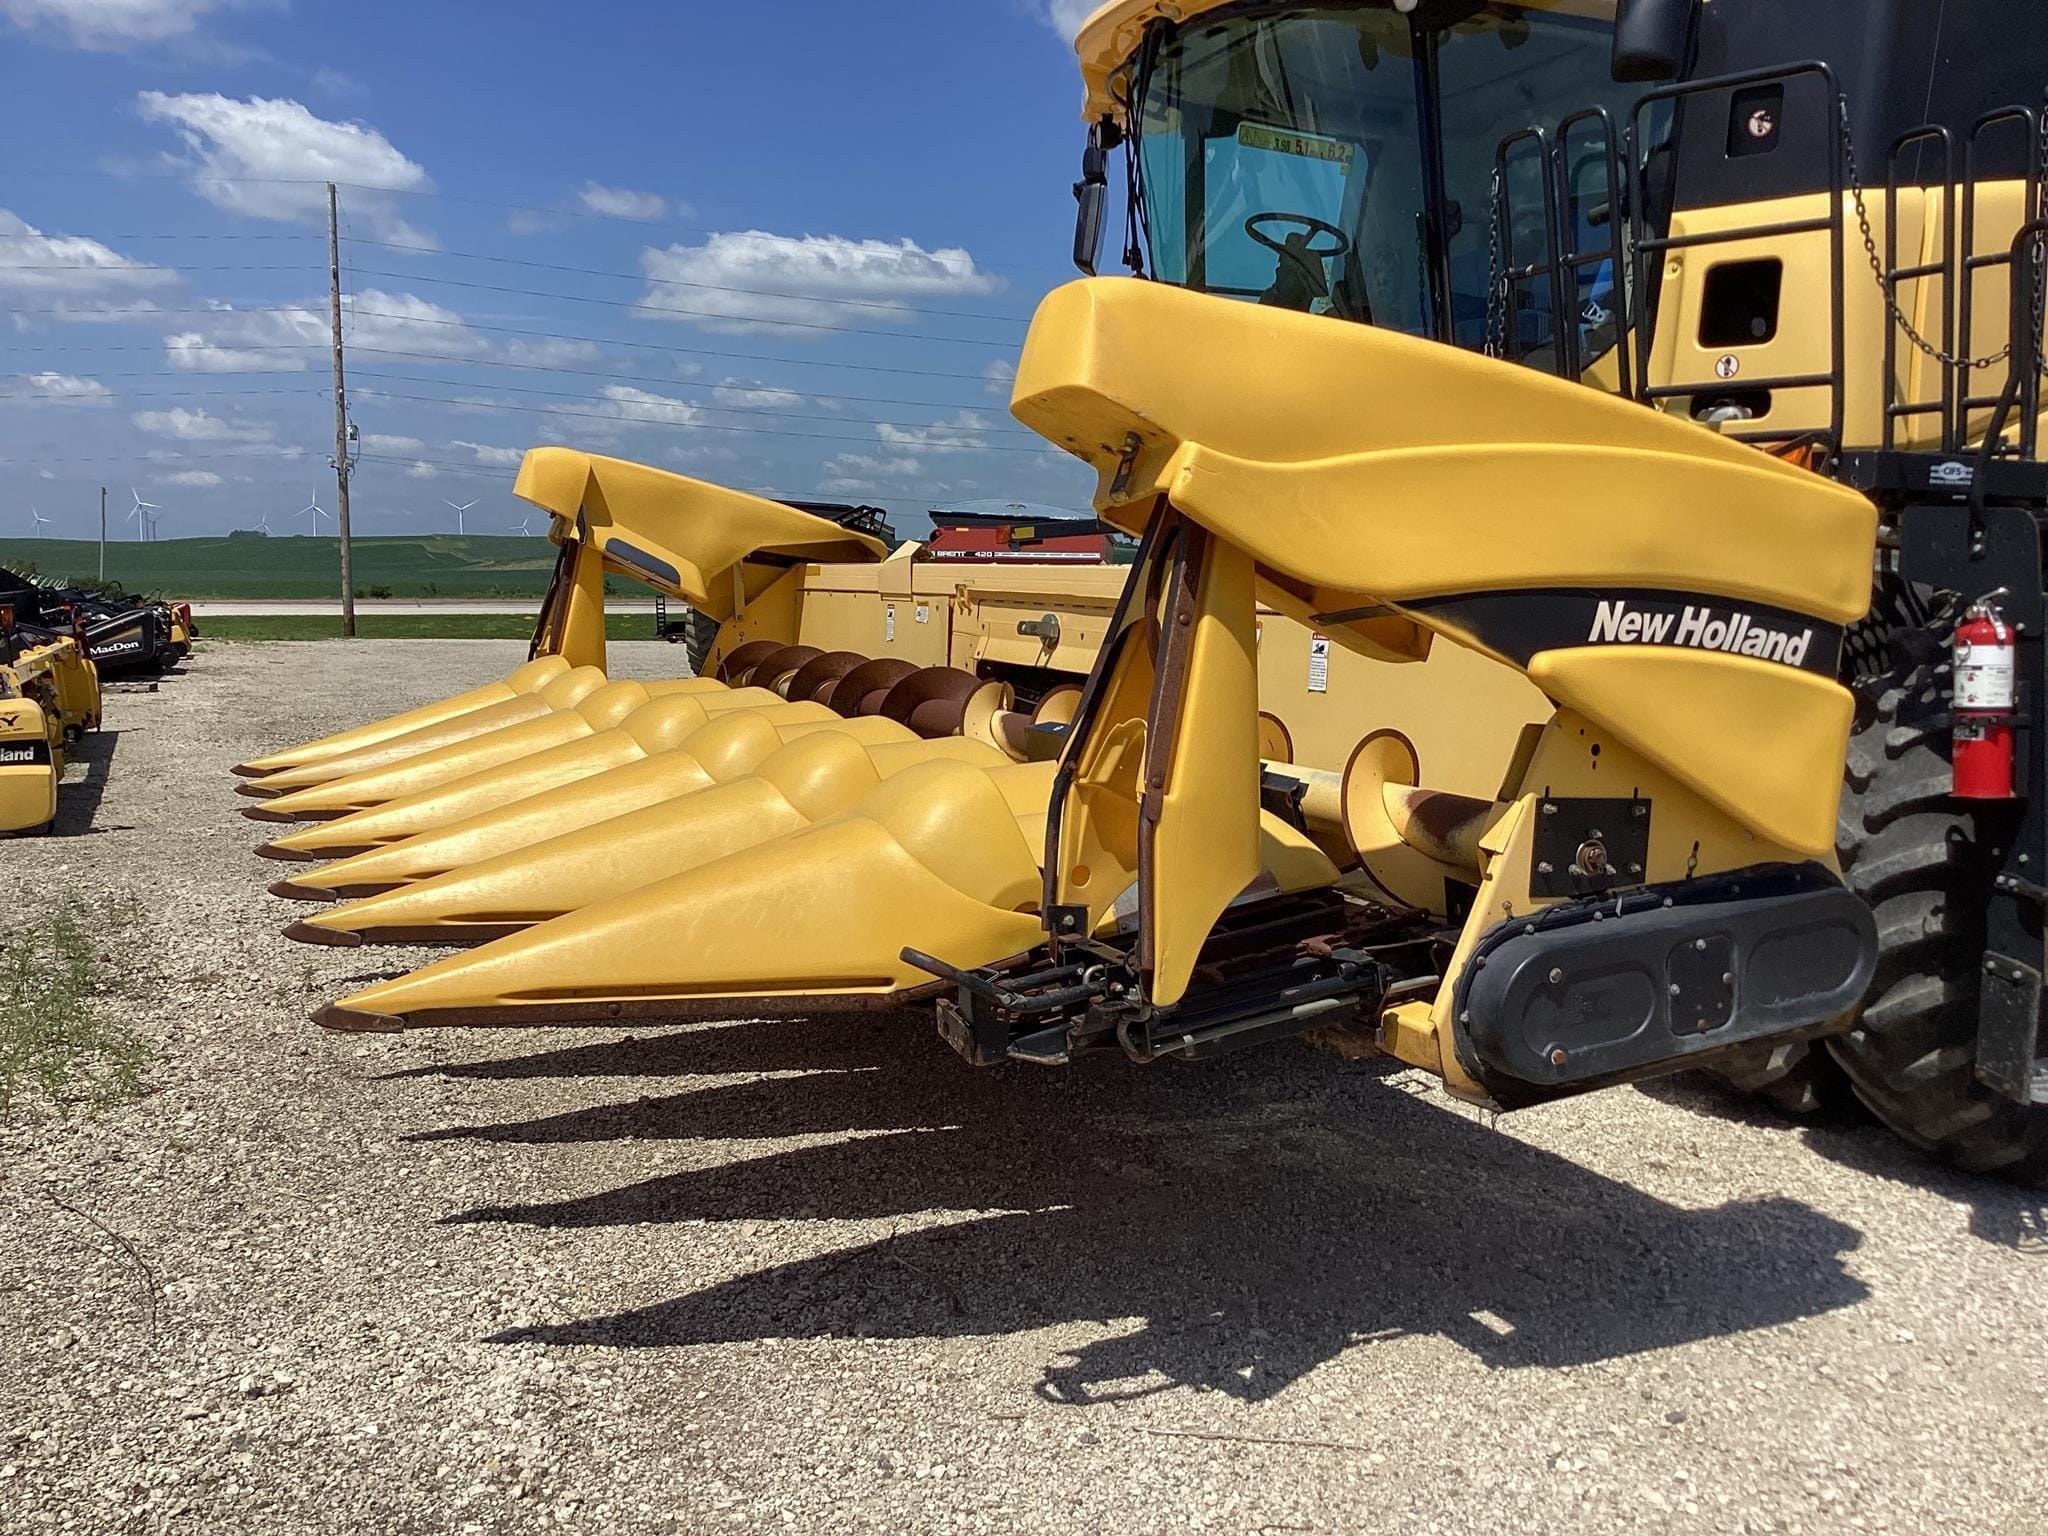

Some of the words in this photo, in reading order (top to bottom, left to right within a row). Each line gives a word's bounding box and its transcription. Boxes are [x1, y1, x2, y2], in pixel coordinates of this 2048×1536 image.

[90, 641, 139, 655] MacDon
[1588, 600, 1675, 643] New
[1674, 606, 1813, 666] Holland
